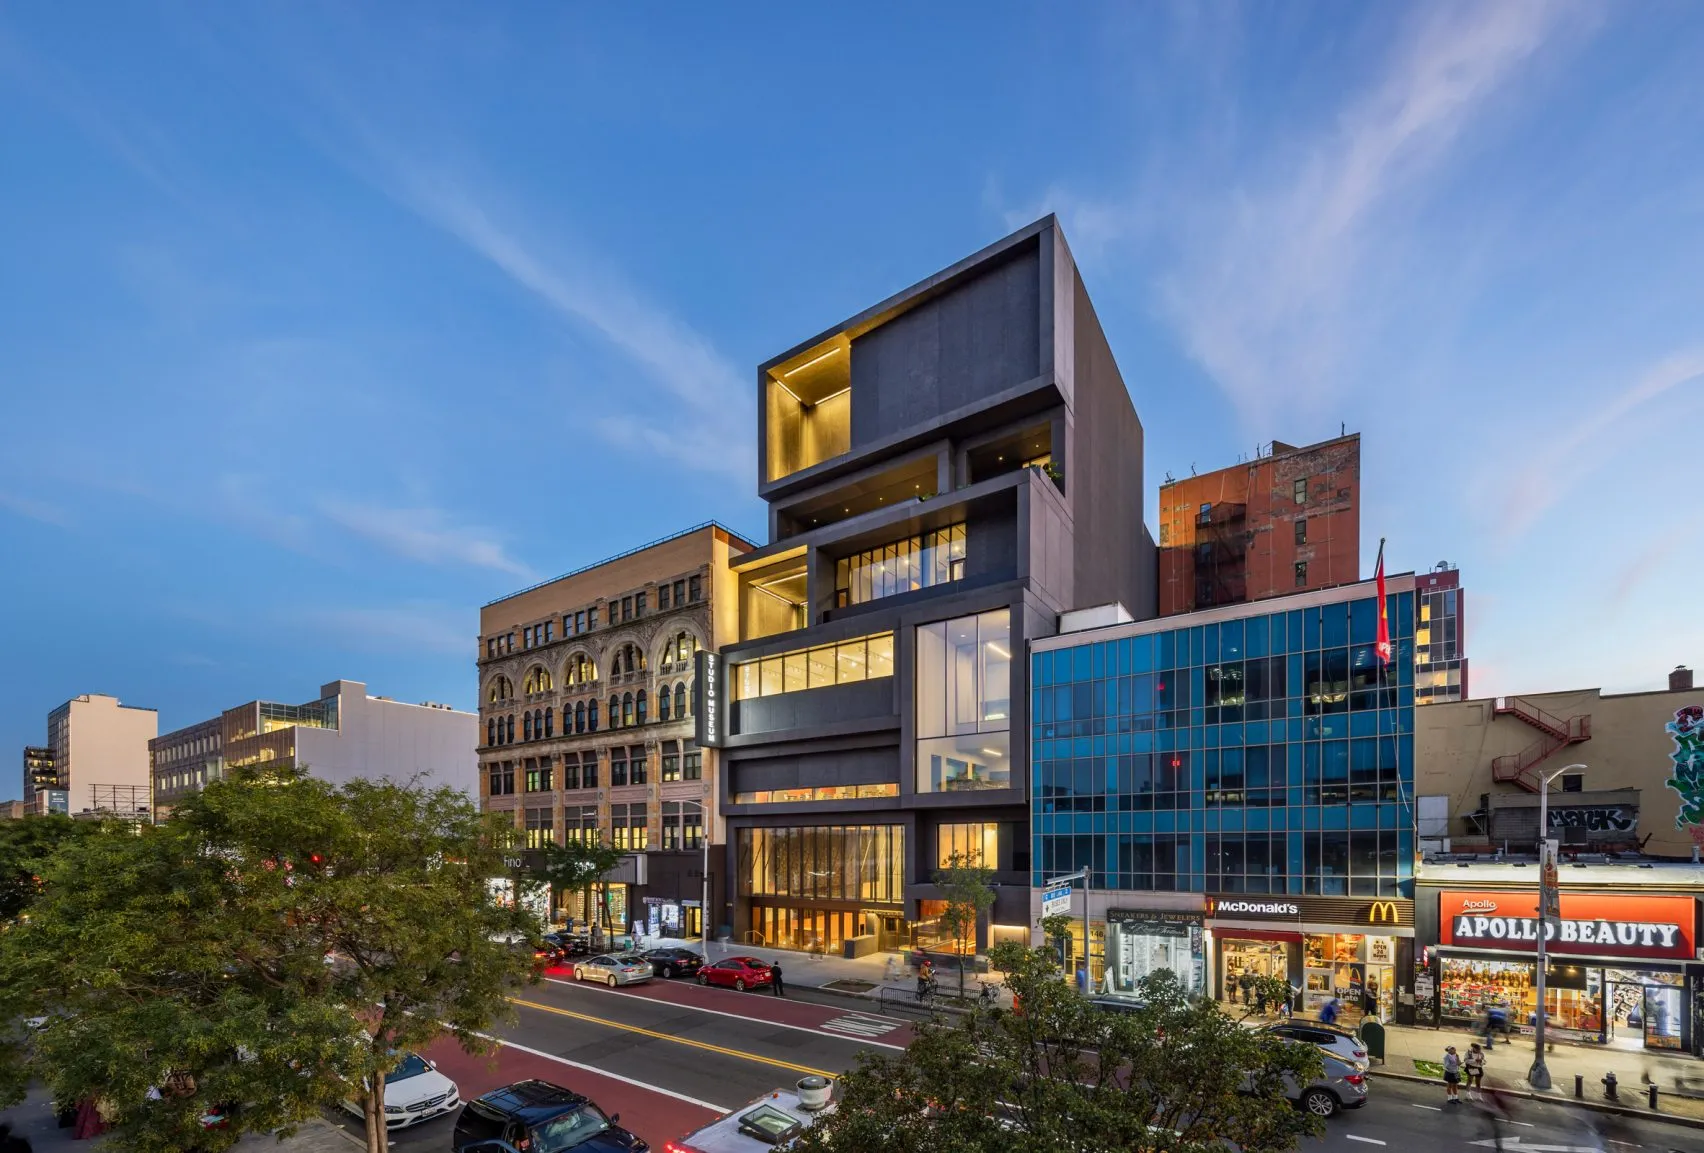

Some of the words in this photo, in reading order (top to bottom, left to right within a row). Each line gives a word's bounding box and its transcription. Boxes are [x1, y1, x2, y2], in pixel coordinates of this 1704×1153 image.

[707, 654, 715, 697] STUDIO
[707, 699, 715, 742] MUSEUM
[1218, 901, 1298, 914] McDonald's
[1463, 899, 1496, 909] Apollo
[1109, 911, 1149, 920] SNEAKERS
[1160, 912, 1201, 921] JEWELERS
[1456, 916, 1554, 941] APOLLO
[1560, 920, 1679, 947] BEAUTY
[1337, 987, 1361, 996] OPEN
[1339, 994, 1359, 1002] Late
